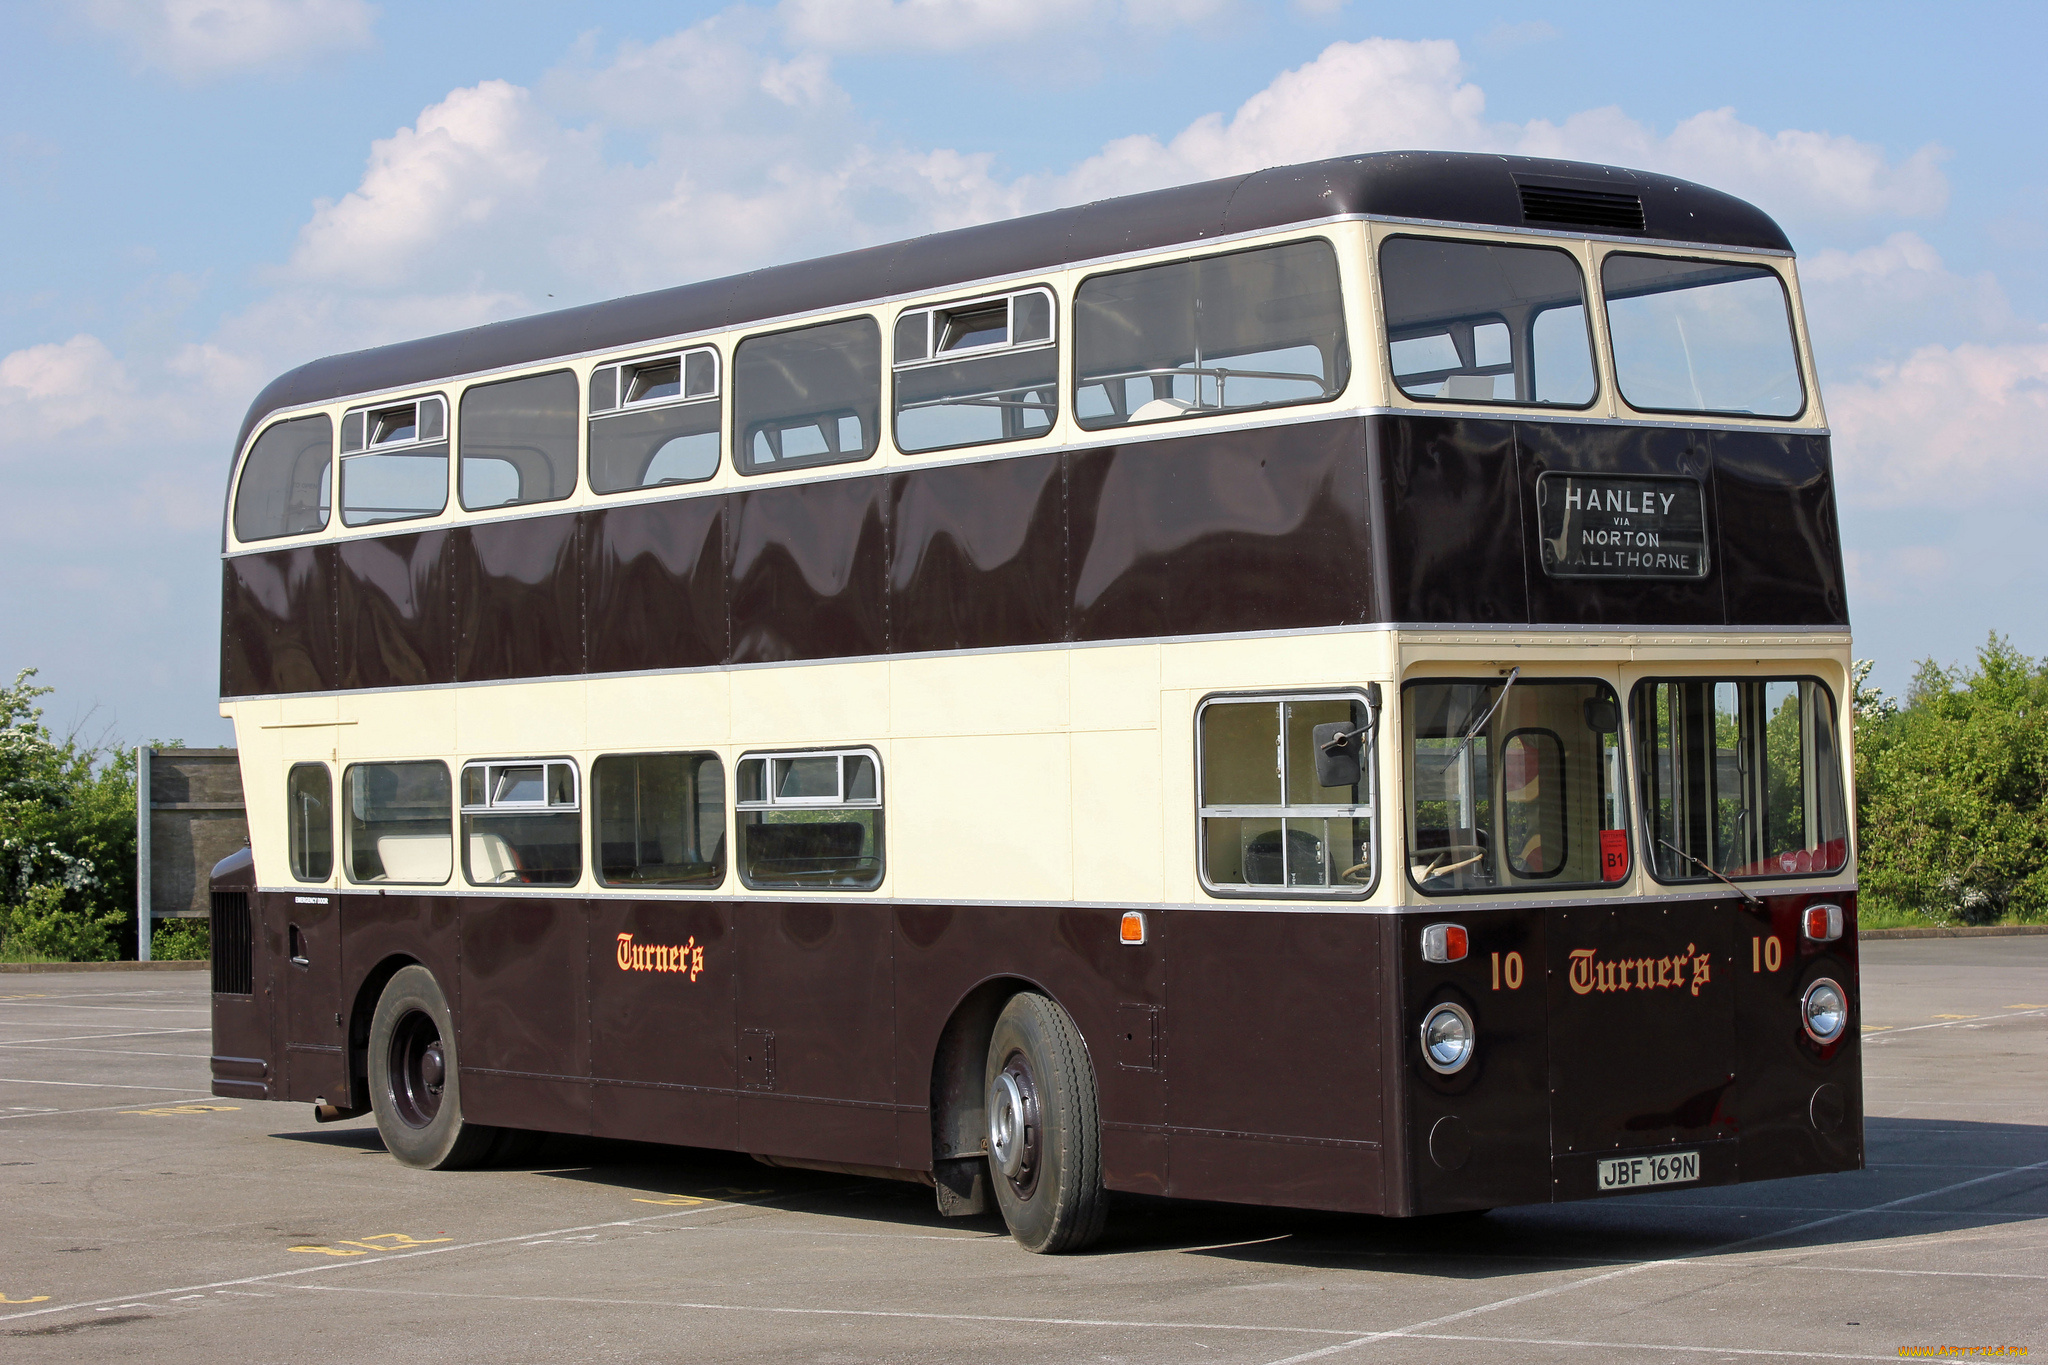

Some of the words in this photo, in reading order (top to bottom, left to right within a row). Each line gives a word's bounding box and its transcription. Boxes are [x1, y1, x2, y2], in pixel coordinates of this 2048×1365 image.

[1565, 487, 1675, 515] HANLEY
[1613, 517, 1630, 526] VIA
[1582, 529, 1660, 548] NORTON
[1607, 852, 1624, 868] B1
[616, 932, 705, 983] Turner's
[1568, 942, 1711, 997] Turner's
[1752, 935, 1783, 973] 10
[1491, 950, 1525, 991] 10
[1604, 1159, 1643, 1186] JBF
[1649, 1154, 1696, 1182] 169N
